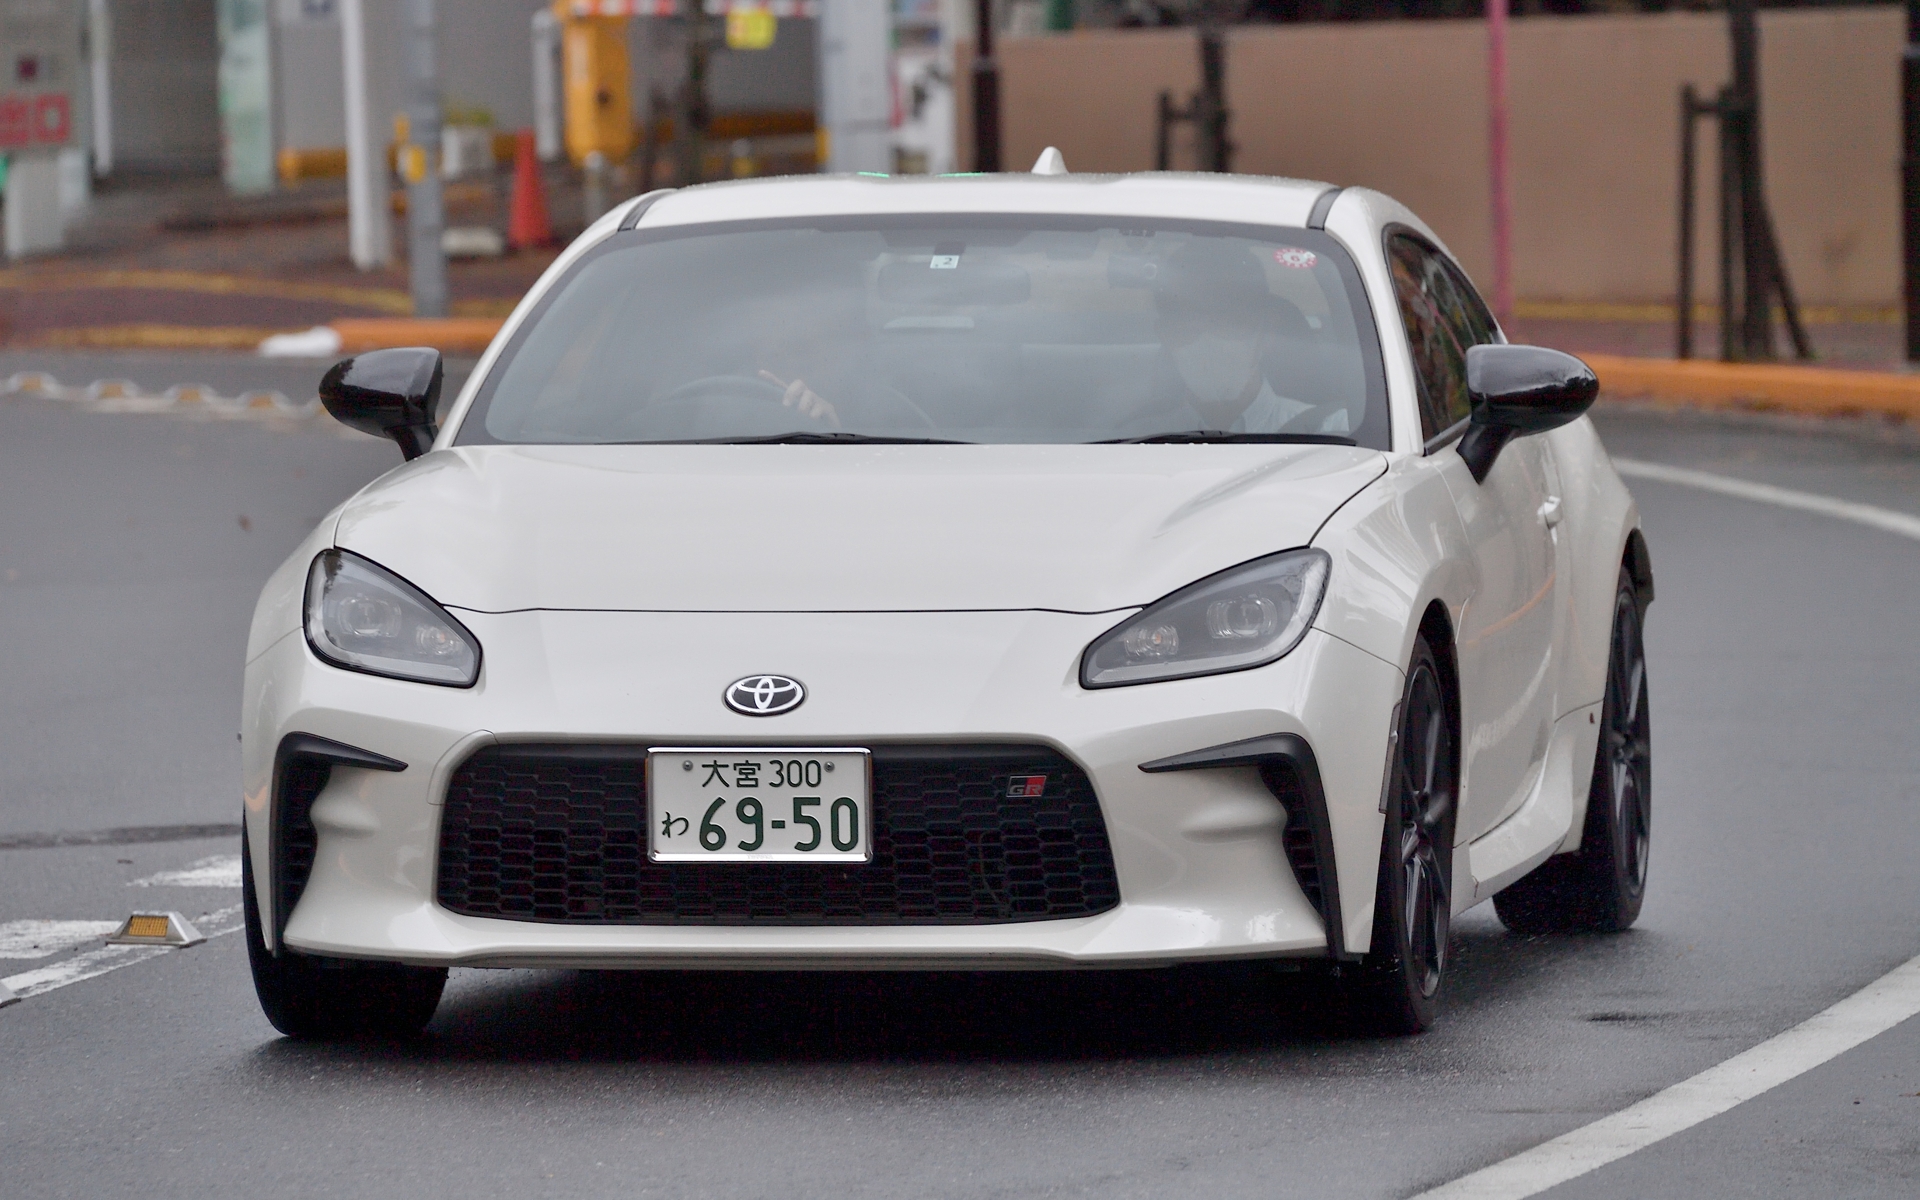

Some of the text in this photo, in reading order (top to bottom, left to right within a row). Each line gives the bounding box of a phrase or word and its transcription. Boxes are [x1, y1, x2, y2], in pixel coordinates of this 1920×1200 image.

[701, 759, 822, 788] 大宮 300
[1009, 784, 1042, 796] GR
[661, 796, 859, 852] わ 69-50
